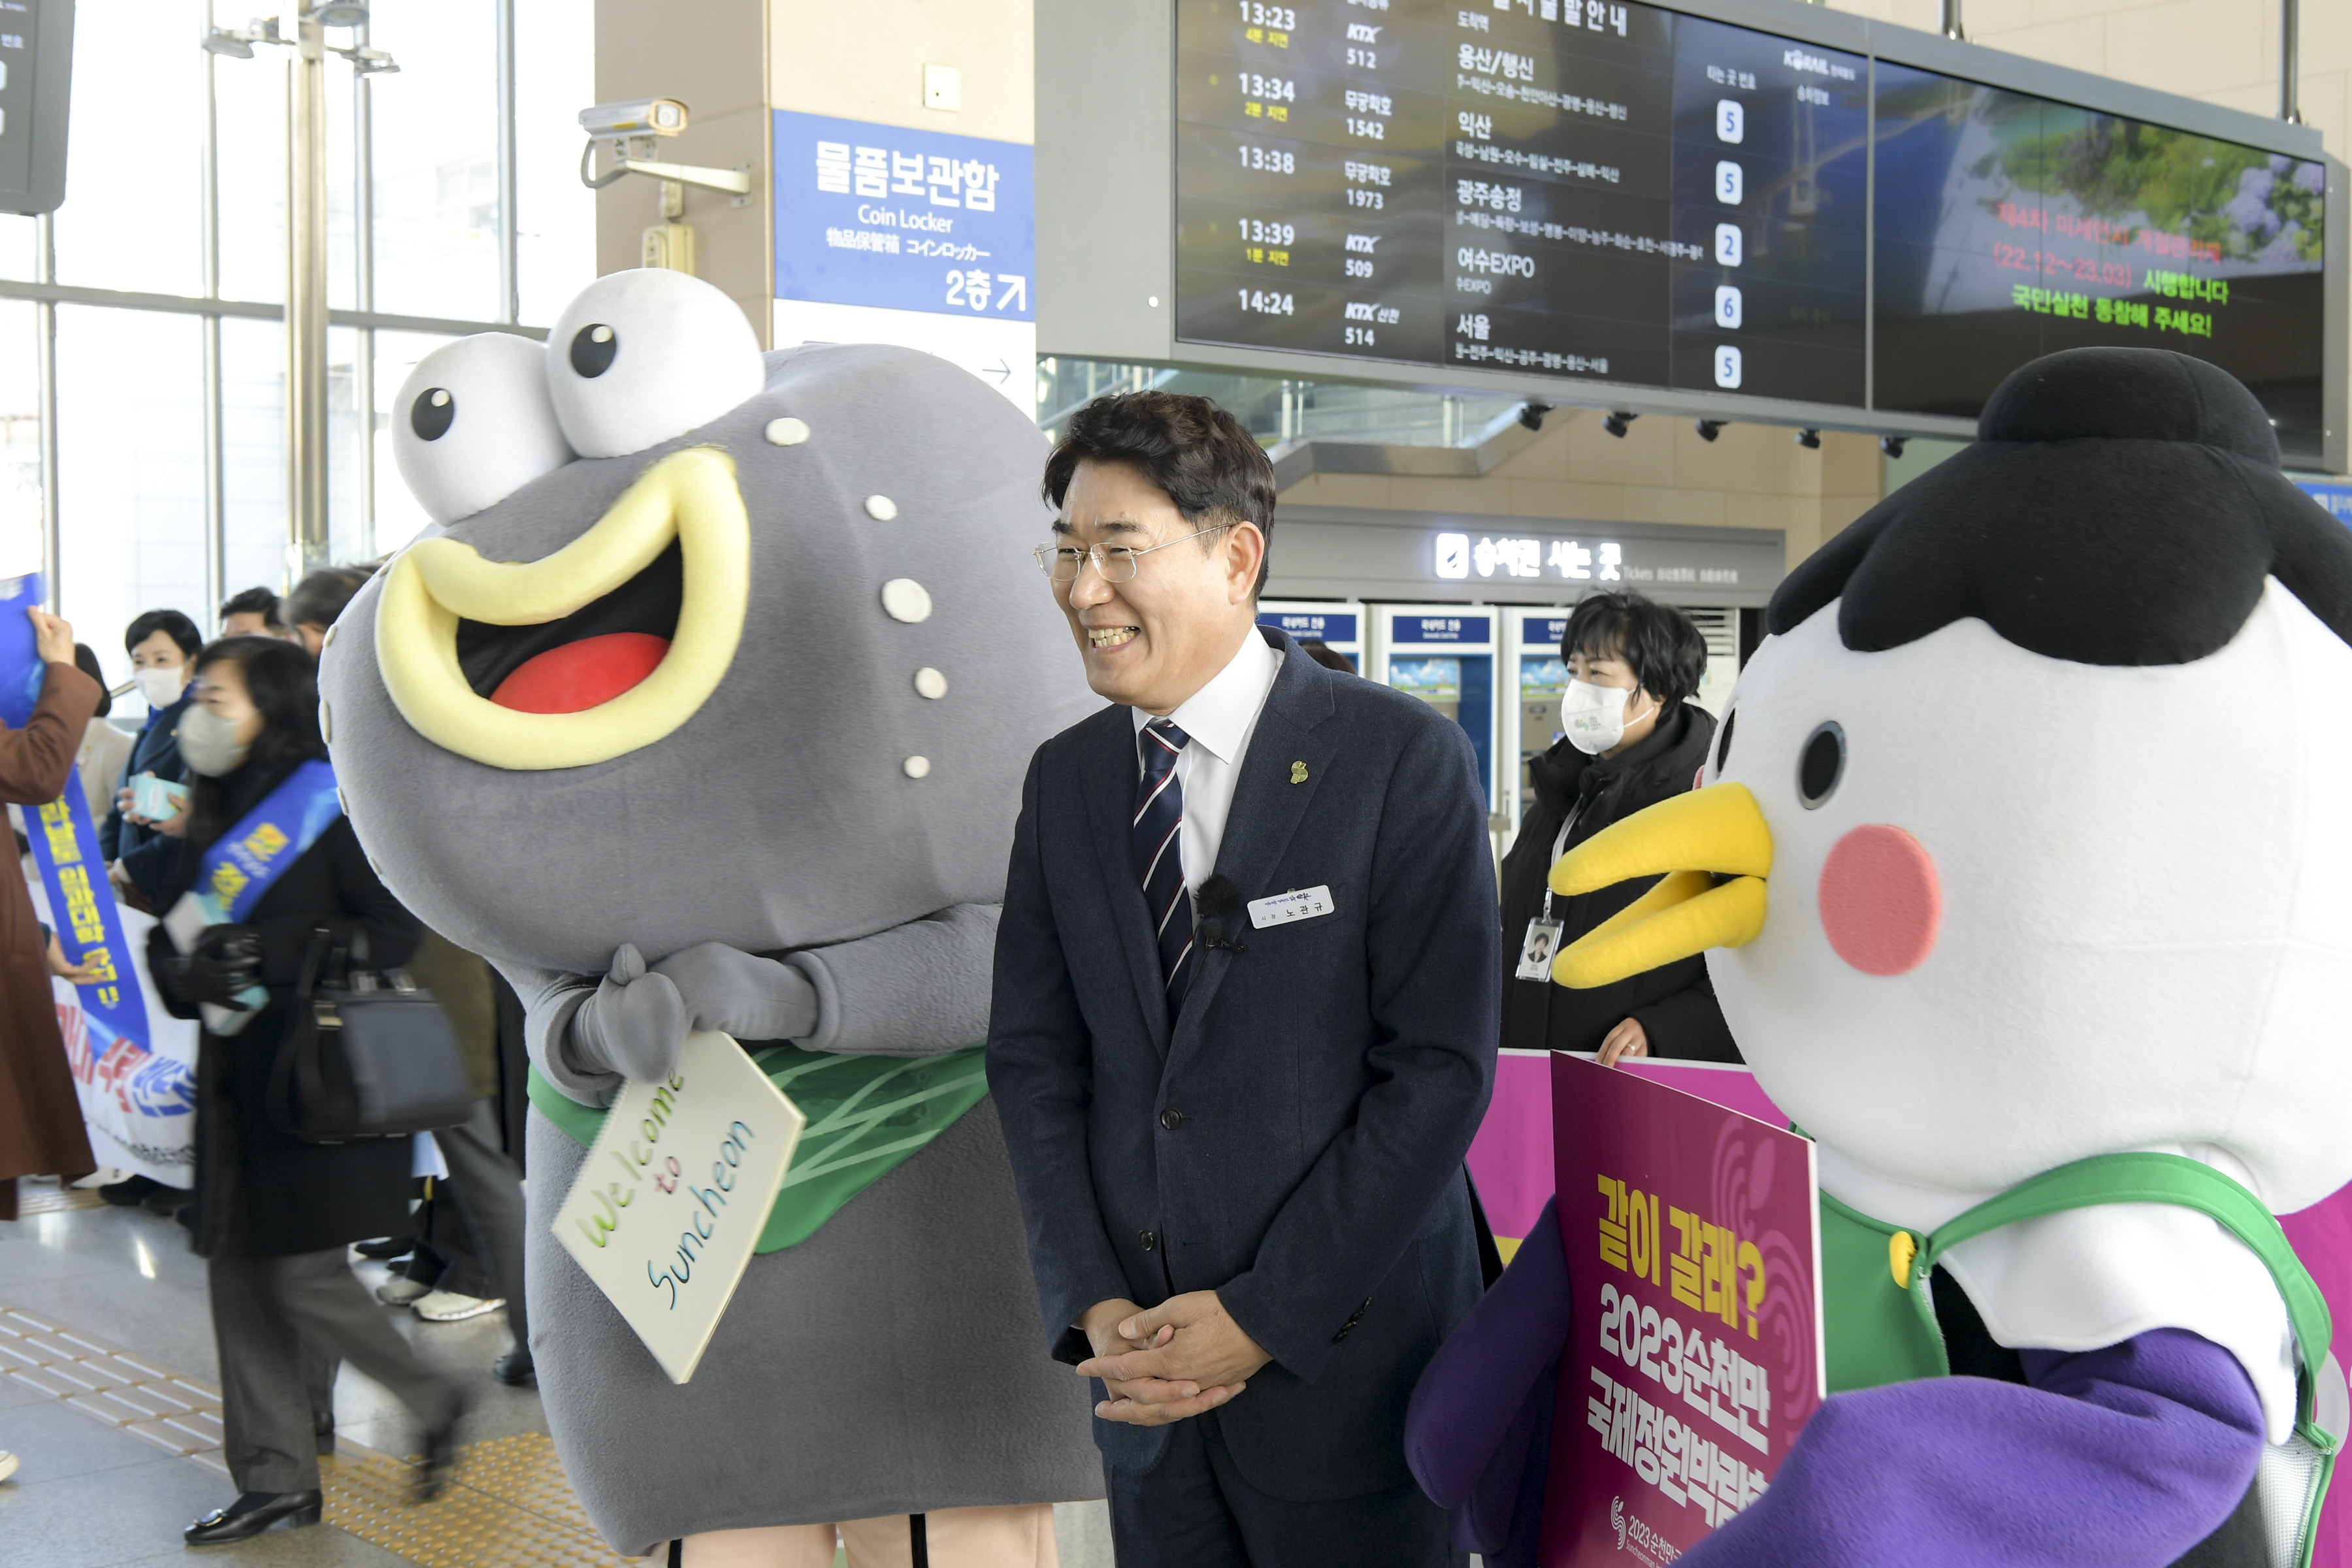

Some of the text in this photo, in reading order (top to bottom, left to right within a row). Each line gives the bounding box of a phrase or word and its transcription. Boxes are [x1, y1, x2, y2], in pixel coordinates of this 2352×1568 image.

[1239, 0, 1296, 31] 13:23
[1347, 23, 1383, 44] KTX
[1347, 48, 1376, 69] 512
[1458, 43, 1534, 81] 용산/행신
[1239, 73, 1295, 102] 13:34
[1345, 90, 1392, 116] 무궁화호
[1347, 118, 1384, 140] 1542
[1458, 111, 1492, 140] 익산
[1725, 112, 1735, 133] 5
[1239, 146, 1295, 174] 13:38
[1345, 161, 1392, 186] 무궁화호
[816, 140, 1000, 212] 물품보관함
[1724, 172, 1734, 193] 5
[1347, 189, 1384, 210] 1973
[1457, 179, 1522, 212] 광주송정
[858, 204, 953, 233] Coin Locker
[1239, 218, 1295, 246] 13:39
[1997, 203, 2049, 234] 제4차
[2056, 214, 2129, 247] 미세먼지
[906, 238, 990, 261] コインロッカー
[1345, 233, 1382, 253] KTX
[1724, 235, 1734, 255] 2
[1345, 259, 1373, 278] 509
[1458, 247, 1535, 278] 여수EXPO
[1993, 241, 2229, 306] (22.12~23.03) 시행합니다
[946, 269, 992, 311] 2층
[1238, 288, 1294, 316] 14:24
[1345, 302, 1381, 321] KTX
[1723, 298, 1733, 318] 6
[2012, 284, 2212, 338] 국민실천 동참해 주세요!
[1345, 327, 1375, 346] 514
[1456, 314, 1490, 340] 서울
[1723, 357, 1733, 378] 5
[1474, 537, 1622, 581] 승차권 사는 곳
[1286, 902, 1323, 917] 노관규
[576, 1068, 684, 1249] Welcome
[654, 1155, 681, 1194] to
[647, 1120, 755, 1311] Suncheon
[1597, 1173, 1765, 1340] 같이 갈래?
